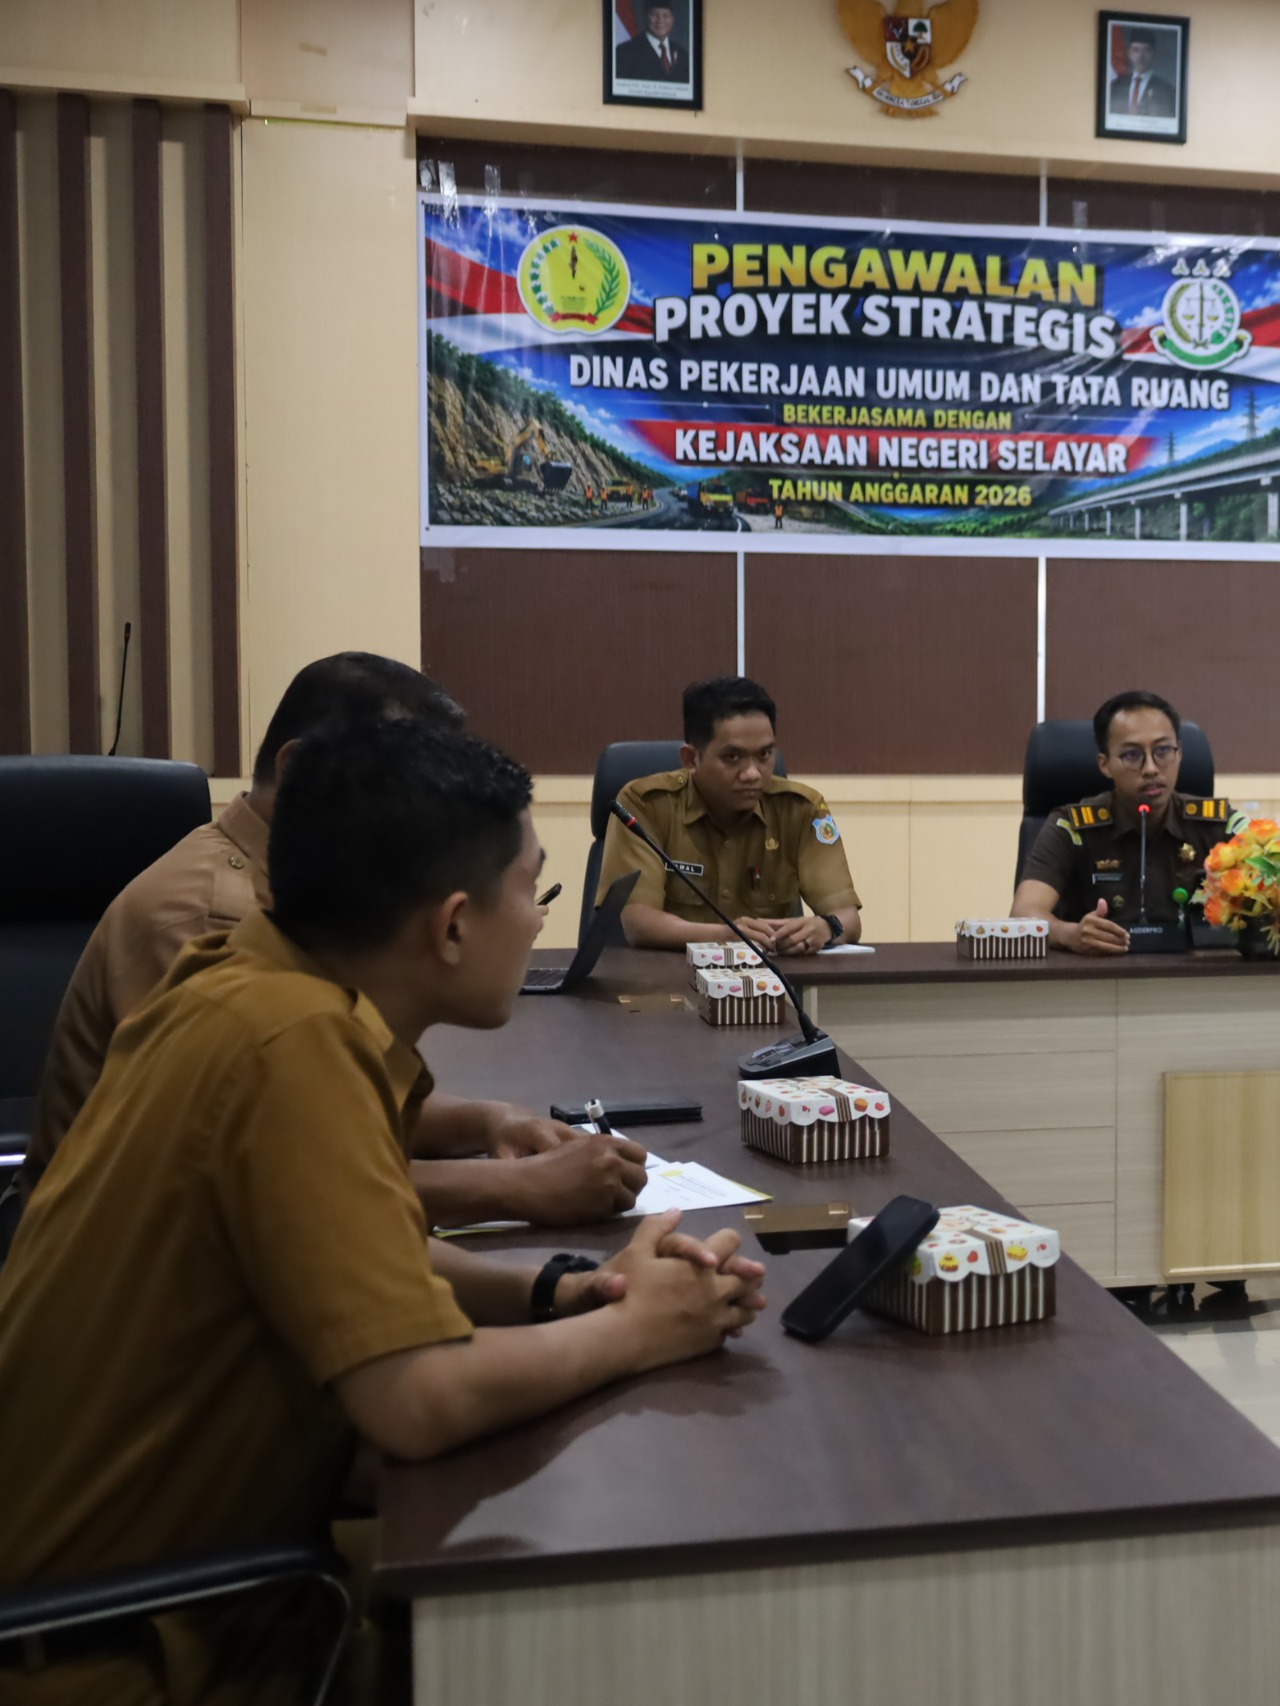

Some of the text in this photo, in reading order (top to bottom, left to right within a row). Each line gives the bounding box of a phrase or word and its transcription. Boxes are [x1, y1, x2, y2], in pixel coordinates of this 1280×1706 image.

[692, 243, 1097, 306] PENGAWALAN
[655, 294, 1117, 358] PROYEK STRATEGIS
[570, 355, 1230, 410] DINAS PEKERJAAN UMUM DAN TATA RUANG
[783, 404, 1012, 430] BEKERJASAMA DENGAN
[675, 429, 1127, 473] KEJAKSAAN NEGERI SELAYAR
[768, 479, 1032, 506] TAHUN ANGGARAN 2026
